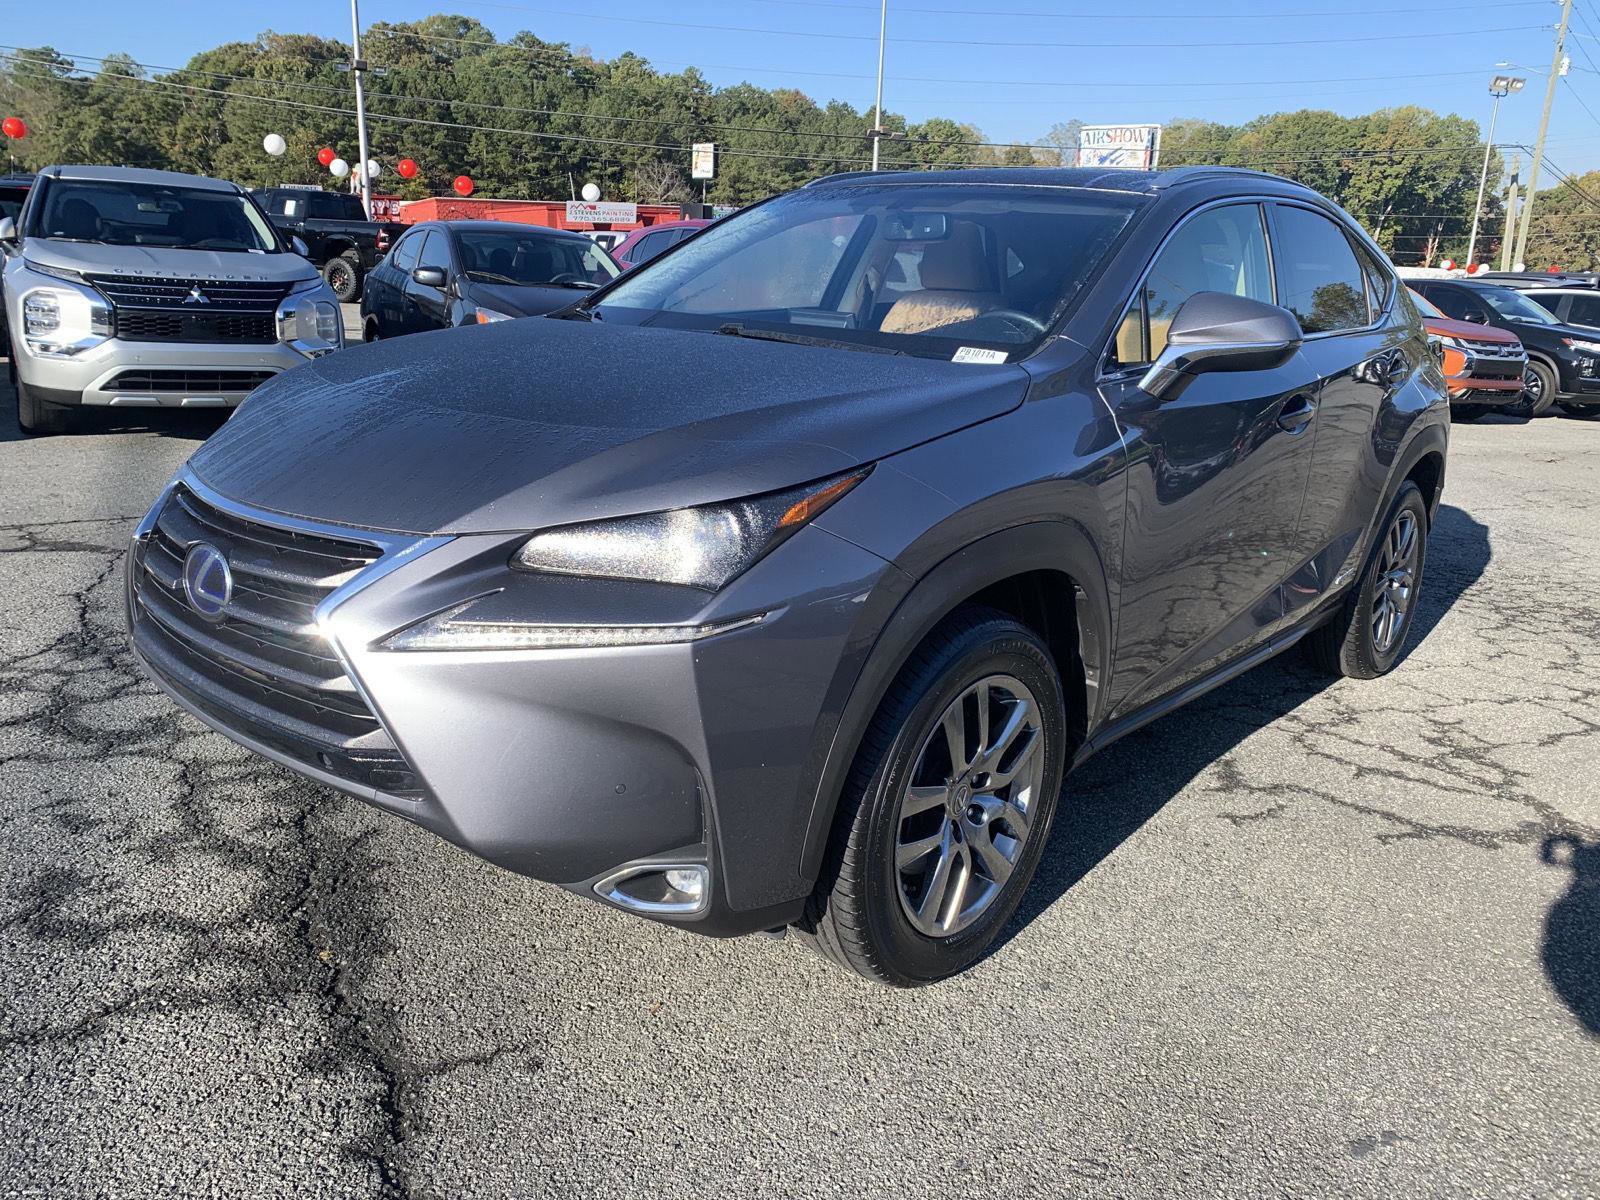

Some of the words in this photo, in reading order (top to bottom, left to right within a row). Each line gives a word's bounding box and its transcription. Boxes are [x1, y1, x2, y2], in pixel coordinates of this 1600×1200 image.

[1083, 128, 1144, 146] AIRSHOW
[113, 267, 269, 281] OUTLANDER
[959, 347, 996, 359] PB1011A
